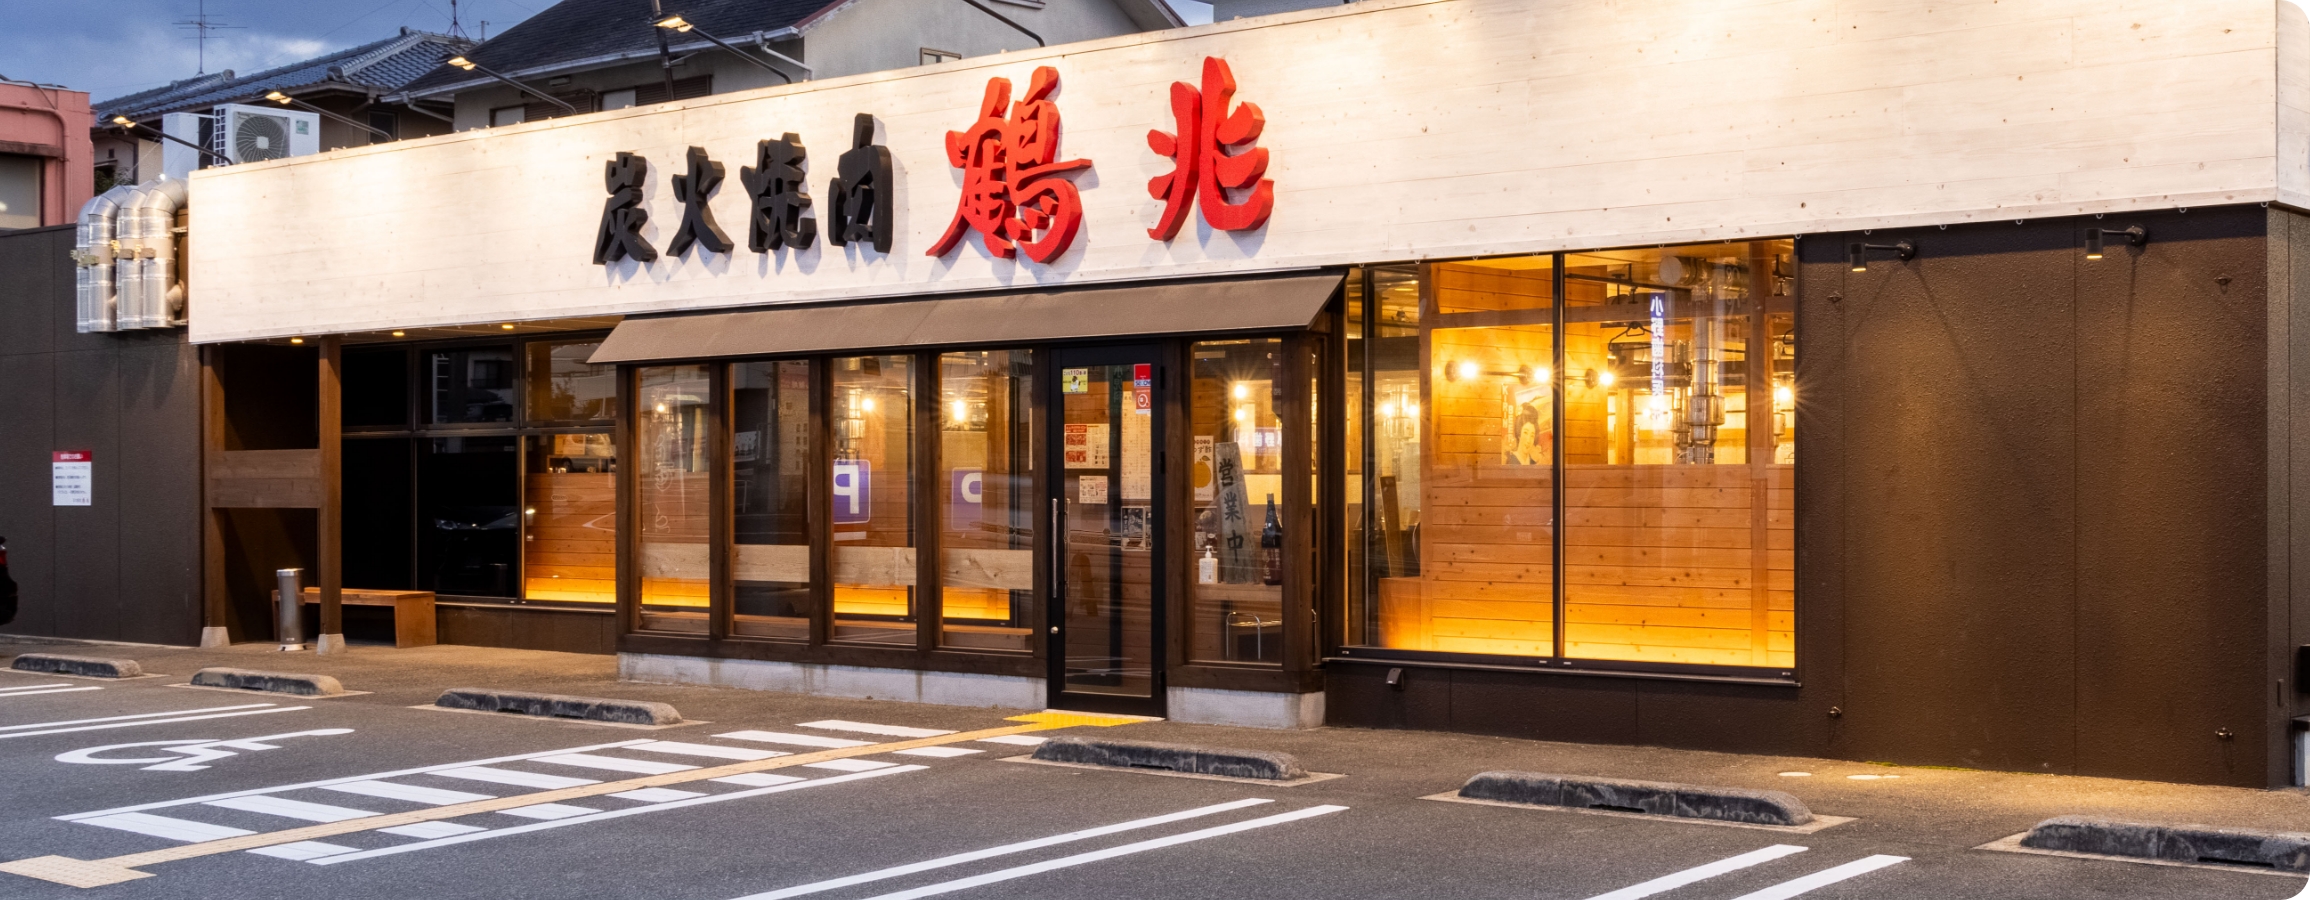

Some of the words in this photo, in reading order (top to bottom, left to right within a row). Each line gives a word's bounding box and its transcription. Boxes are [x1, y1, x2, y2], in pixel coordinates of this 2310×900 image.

[593, 113, 893, 265] 炭火焼肉
[926, 56, 1274, 263] 鶴兆
[1219, 458, 1244, 562] 営業中
